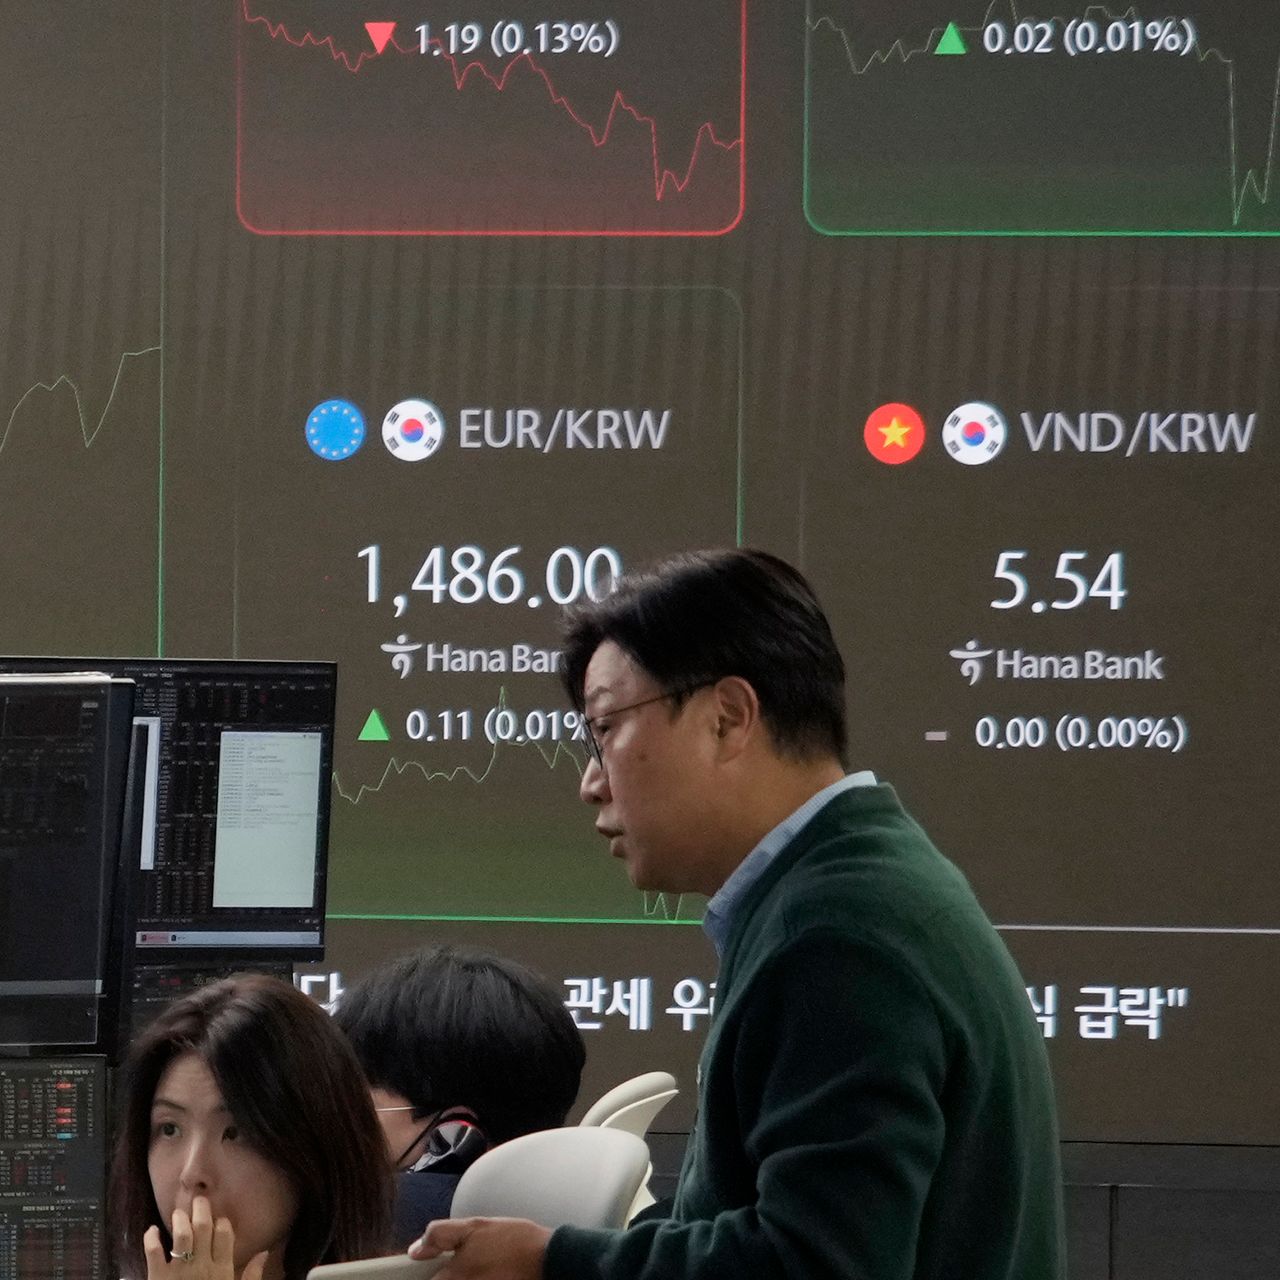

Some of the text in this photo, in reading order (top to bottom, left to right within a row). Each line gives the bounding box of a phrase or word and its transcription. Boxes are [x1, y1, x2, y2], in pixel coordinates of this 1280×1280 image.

[414, 20, 619, 58] 1.19 (0.13%)
[983, 19, 1196, 57] 0.02 (0.01%)
[459, 408, 672, 454] EUR/KRW
[1020, 411, 1257, 457] VND/KRW
[357, 544, 623, 618] 1,486.00
[990, 551, 1128, 615] 5.54
[426, 643, 506, 673] Hana
[996, 649, 1165, 680] Hana Bank
[405, 706, 587, 746] 0.11 (0.01%
[975, 715, 1187, 754] 0.00 (0.00%)
[563, 977, 654, 1033] 관세
[664, 977, 718, 1032] 우
[1073, 984, 1189, 1041] 급락"
